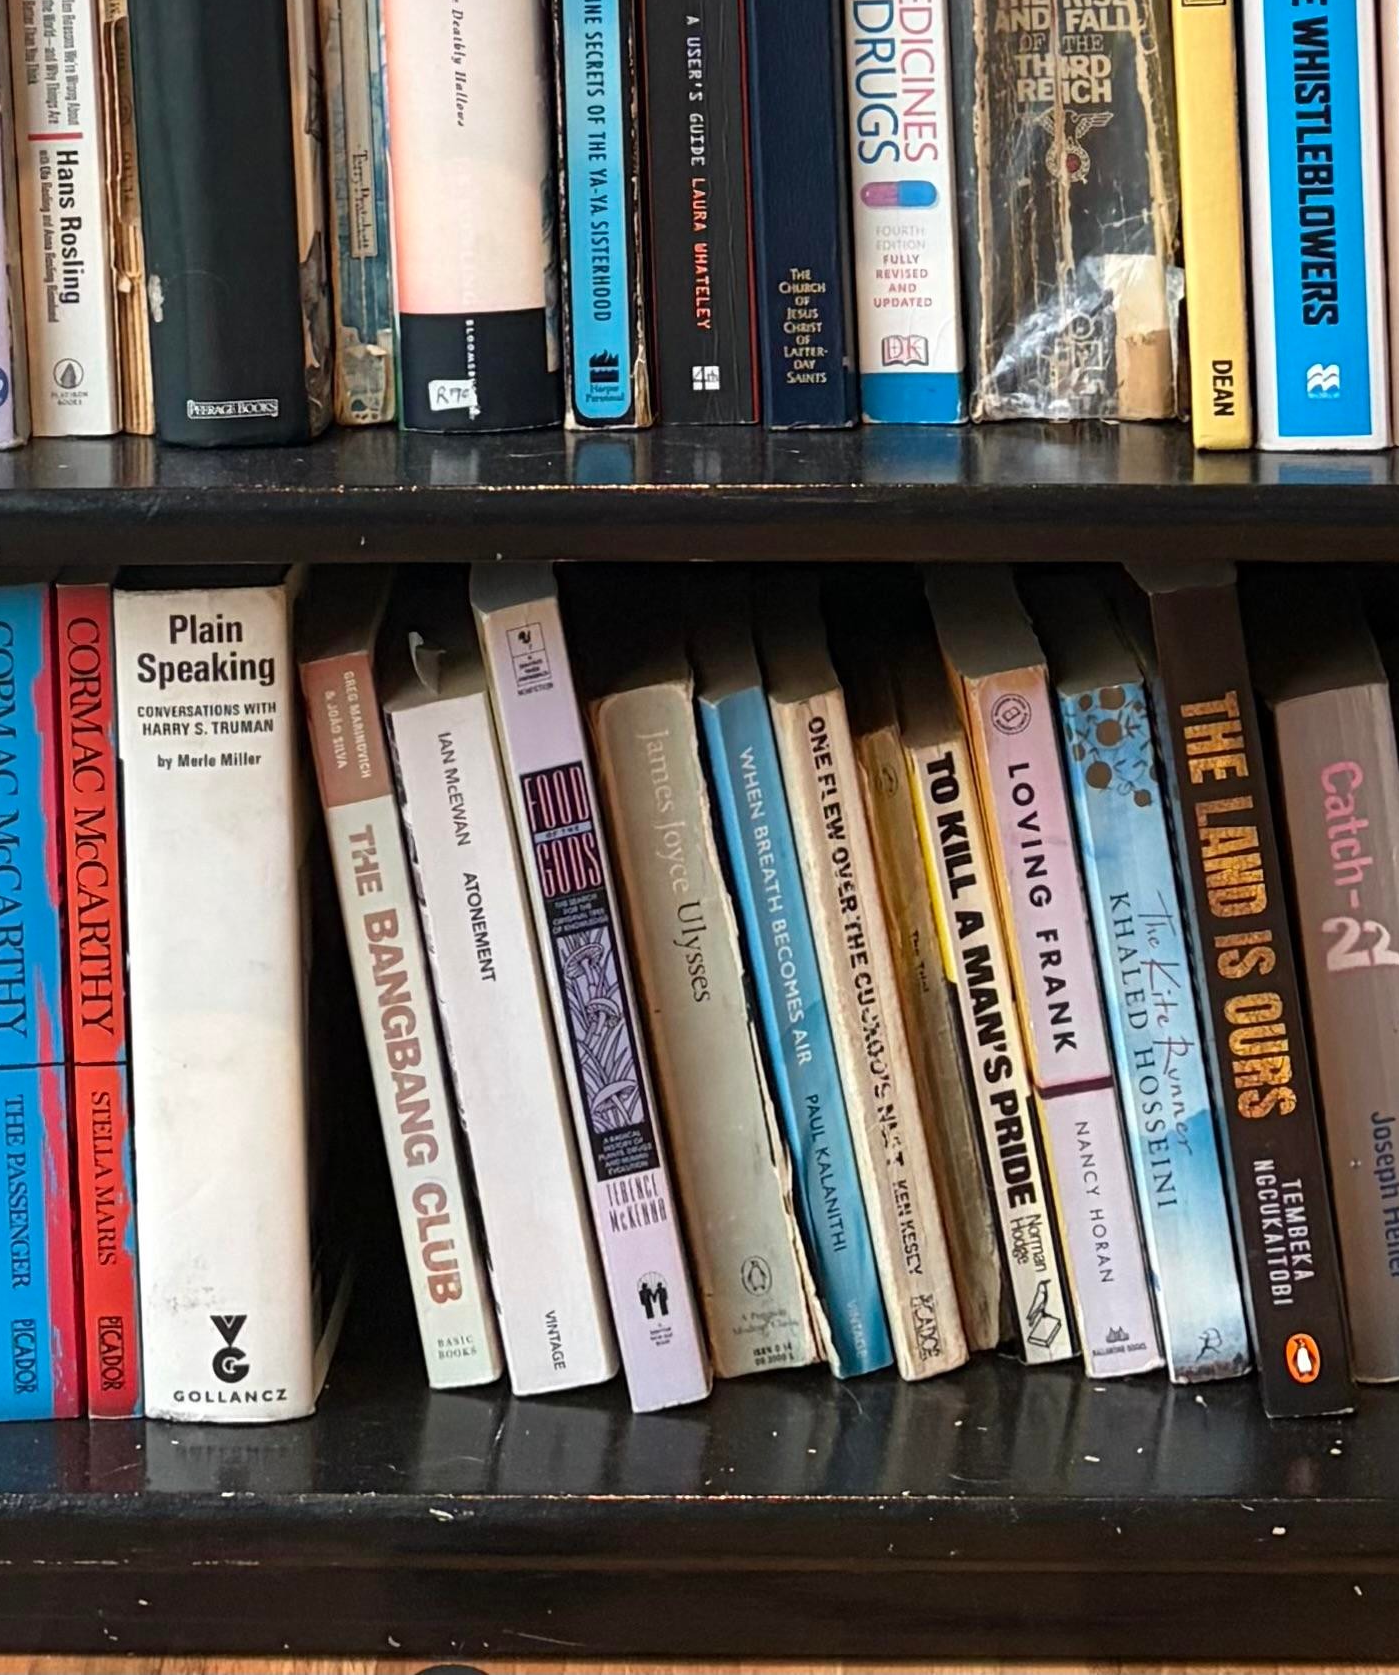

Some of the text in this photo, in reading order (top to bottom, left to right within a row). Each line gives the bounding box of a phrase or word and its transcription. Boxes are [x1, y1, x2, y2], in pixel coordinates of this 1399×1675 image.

[1293, 15, 1339, 326] WHISTLEBLOWERS
[873, 296, 932, 308] UPDATED
[875, 269, 928, 280] REVISED
[1212, 359, 1235, 417] DEAN
[137, 651, 275, 689] Speaking
[169, 614, 244, 645] Plain
[137, 702, 277, 719] CONVERSATIONS WITH
[463, 873, 497, 982] ATONEMENT
[677, 899, 711, 1003] Ulysses
[1008, 763, 1077, 1055] LOVING FRANK
[1110, 892, 1178, 1209] KHALED HOSSEINI
[364, 909, 463, 1306] BANGBANG CLUB
[989, 1093, 1037, 1209] PRIDE
[90, 1092, 117, 1265] STELLA MARIS
[805, 1094, 847, 1253] PAUL KALANITHI
[1253, 1159, 1294, 1306] NGCUKAITOBI
[1280, 1179, 1314, 1283] TEMBEKA
[174, 1388, 288, 1403] GOLLANCZ
